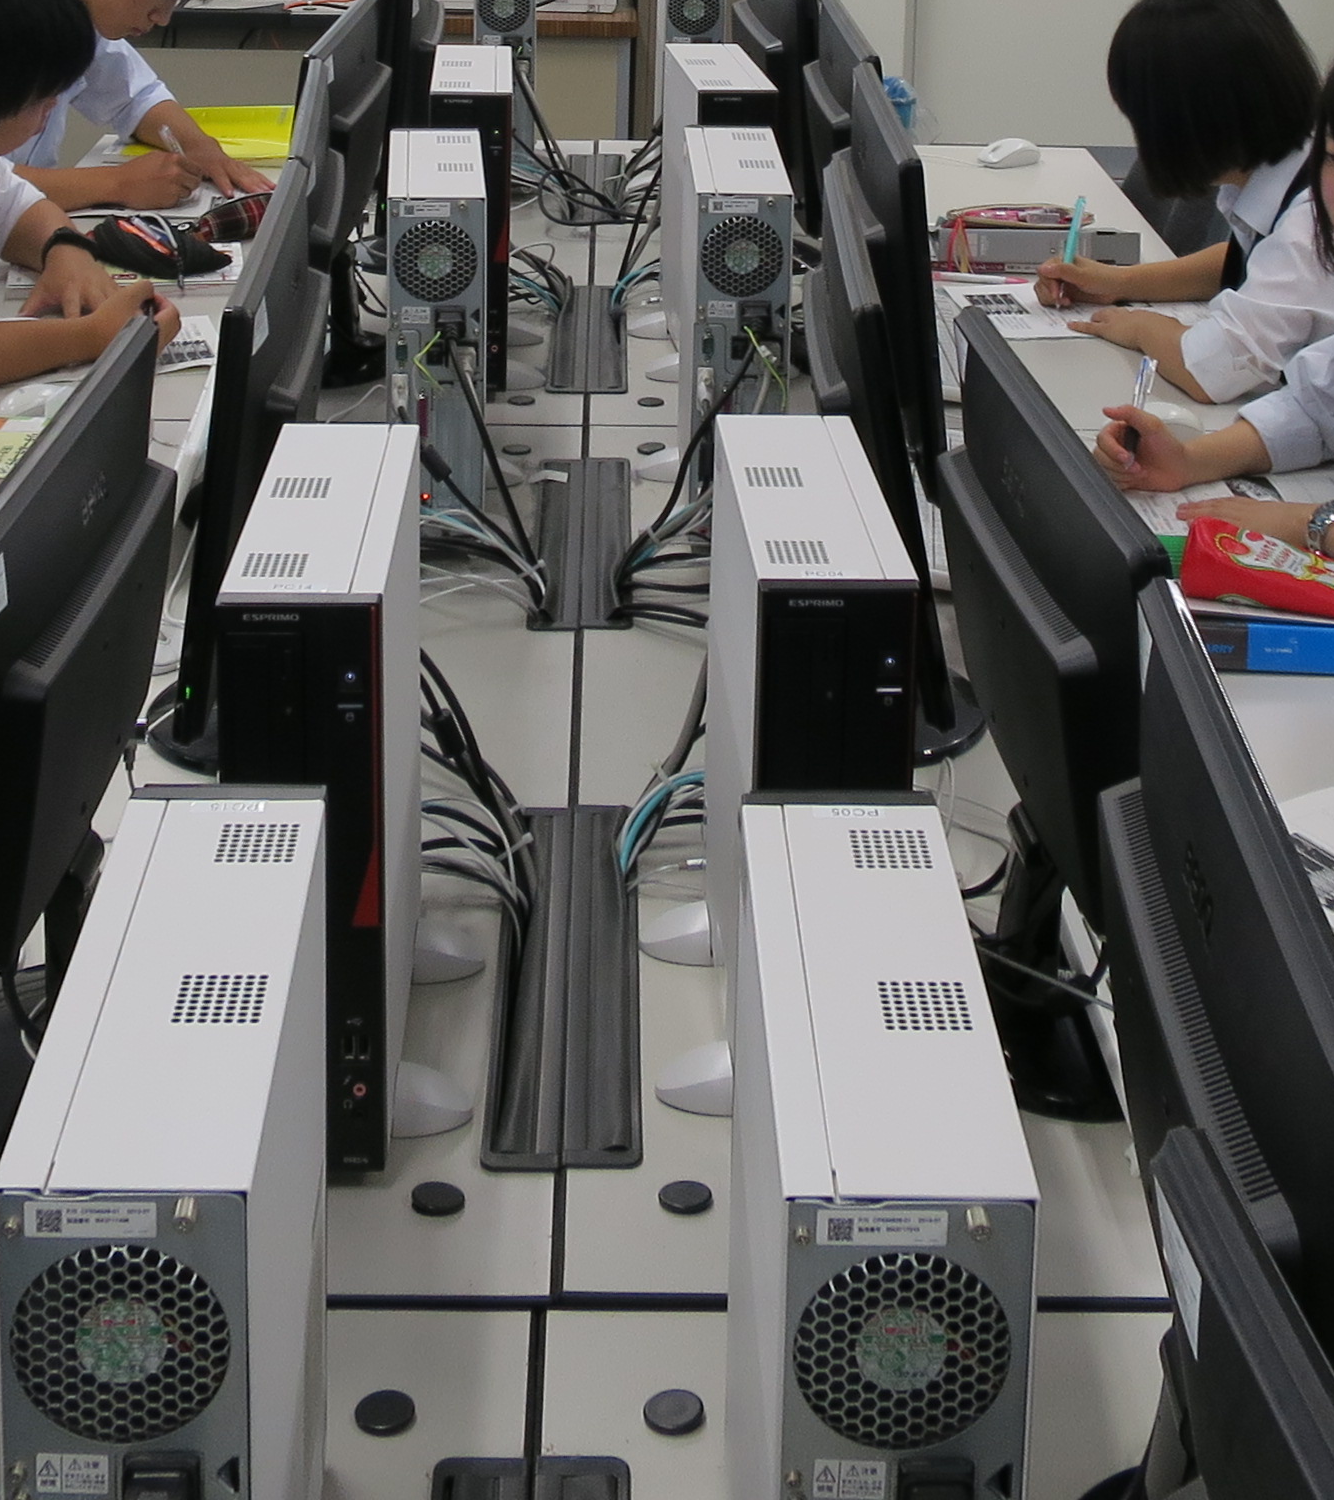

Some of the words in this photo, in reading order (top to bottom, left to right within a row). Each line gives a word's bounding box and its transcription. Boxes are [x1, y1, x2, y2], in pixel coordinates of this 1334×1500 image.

[788, 599, 845, 608] ESPRIMO
[242, 613, 300, 622] ESPRIMO
[831, 807, 880, 817] PC05
